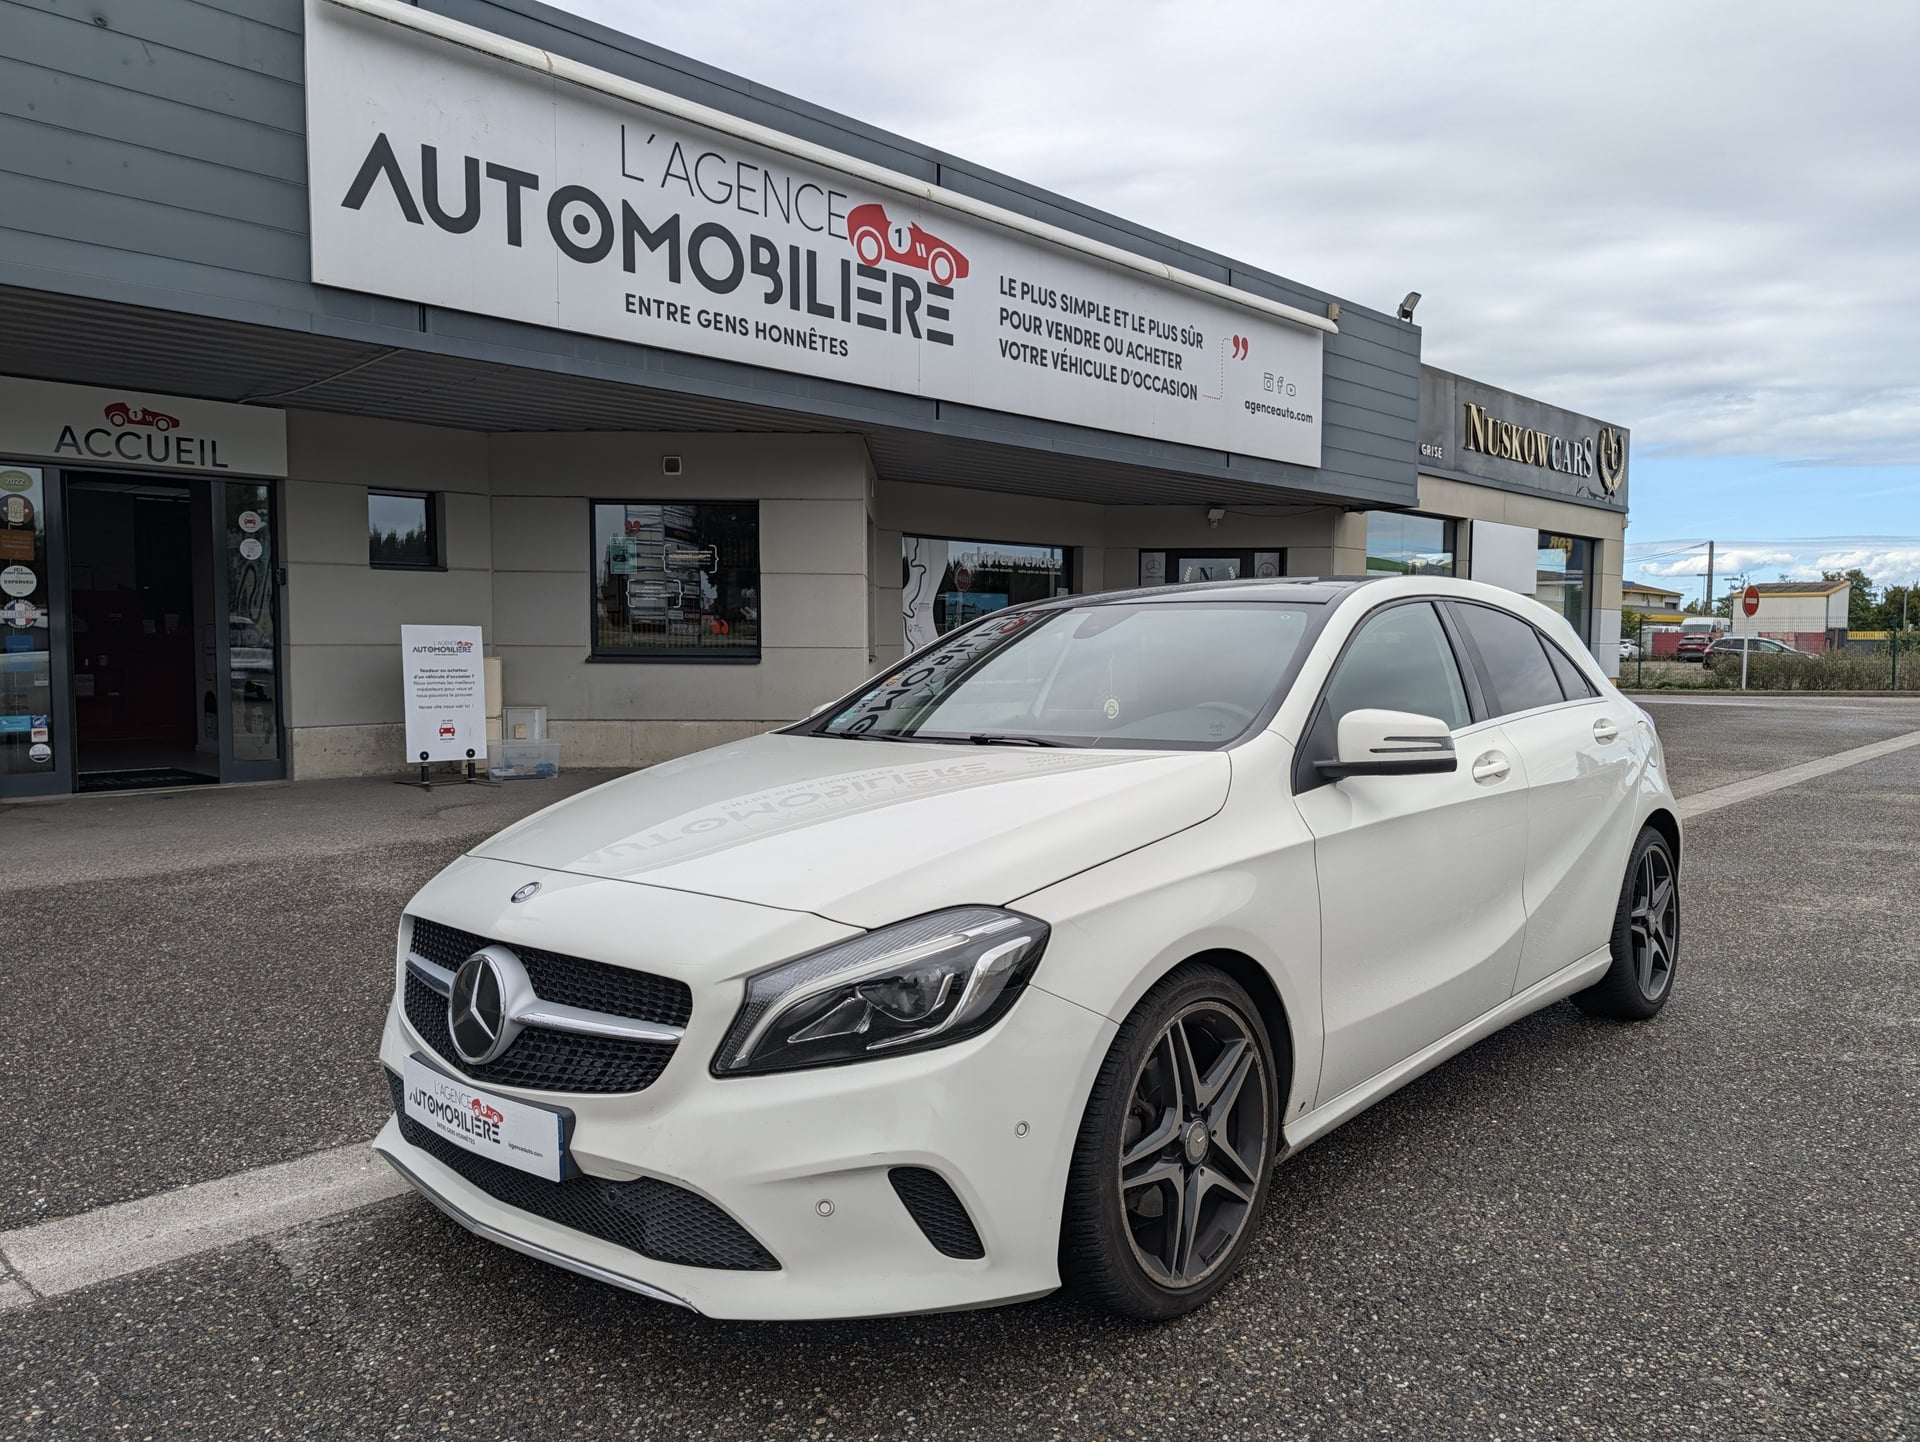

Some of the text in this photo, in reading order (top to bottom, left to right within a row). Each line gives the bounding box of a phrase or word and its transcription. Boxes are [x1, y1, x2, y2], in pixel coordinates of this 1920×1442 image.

[624, 292, 849, 358] ENTRE GENS HONNÊTES
[1000, 275, 1204, 350] LE PLUS SIMPLE ET LE PLUS SÛR
[999, 307, 1183, 371] POUR VENDRE OU ACHETER
[999, 337, 1198, 401] VOTRE VÉHICULE D'OCCASION
[1244, 399, 1313, 424] agenceauto.com
[54, 425, 229, 469] ACCUEIL
[1420, 443, 1443, 460] GRISE
[433, 1080, 472, 1110] L'AGENCE
[508, 1142, 544, 1159] agenceauto.com
